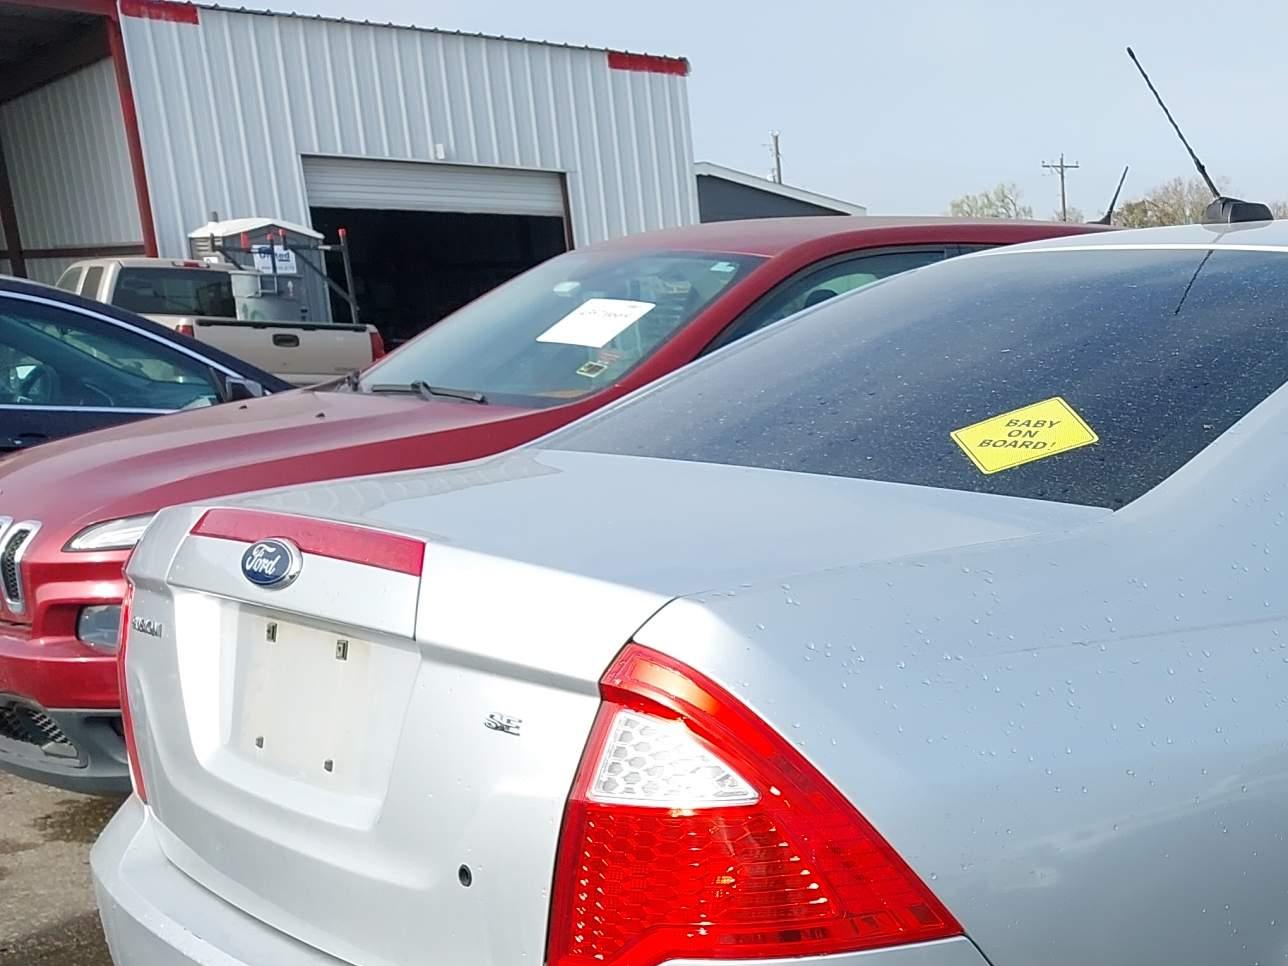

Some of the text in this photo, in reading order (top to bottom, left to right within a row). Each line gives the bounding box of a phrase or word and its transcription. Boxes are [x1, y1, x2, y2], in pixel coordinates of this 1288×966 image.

[1005, 418, 1061, 428] BABY
[1007, 429, 1039, 438] ON
[977, 438, 1056, 450] BOARD!
[245, 543, 281, 575] Ford
[484, 712, 523, 736] SE
